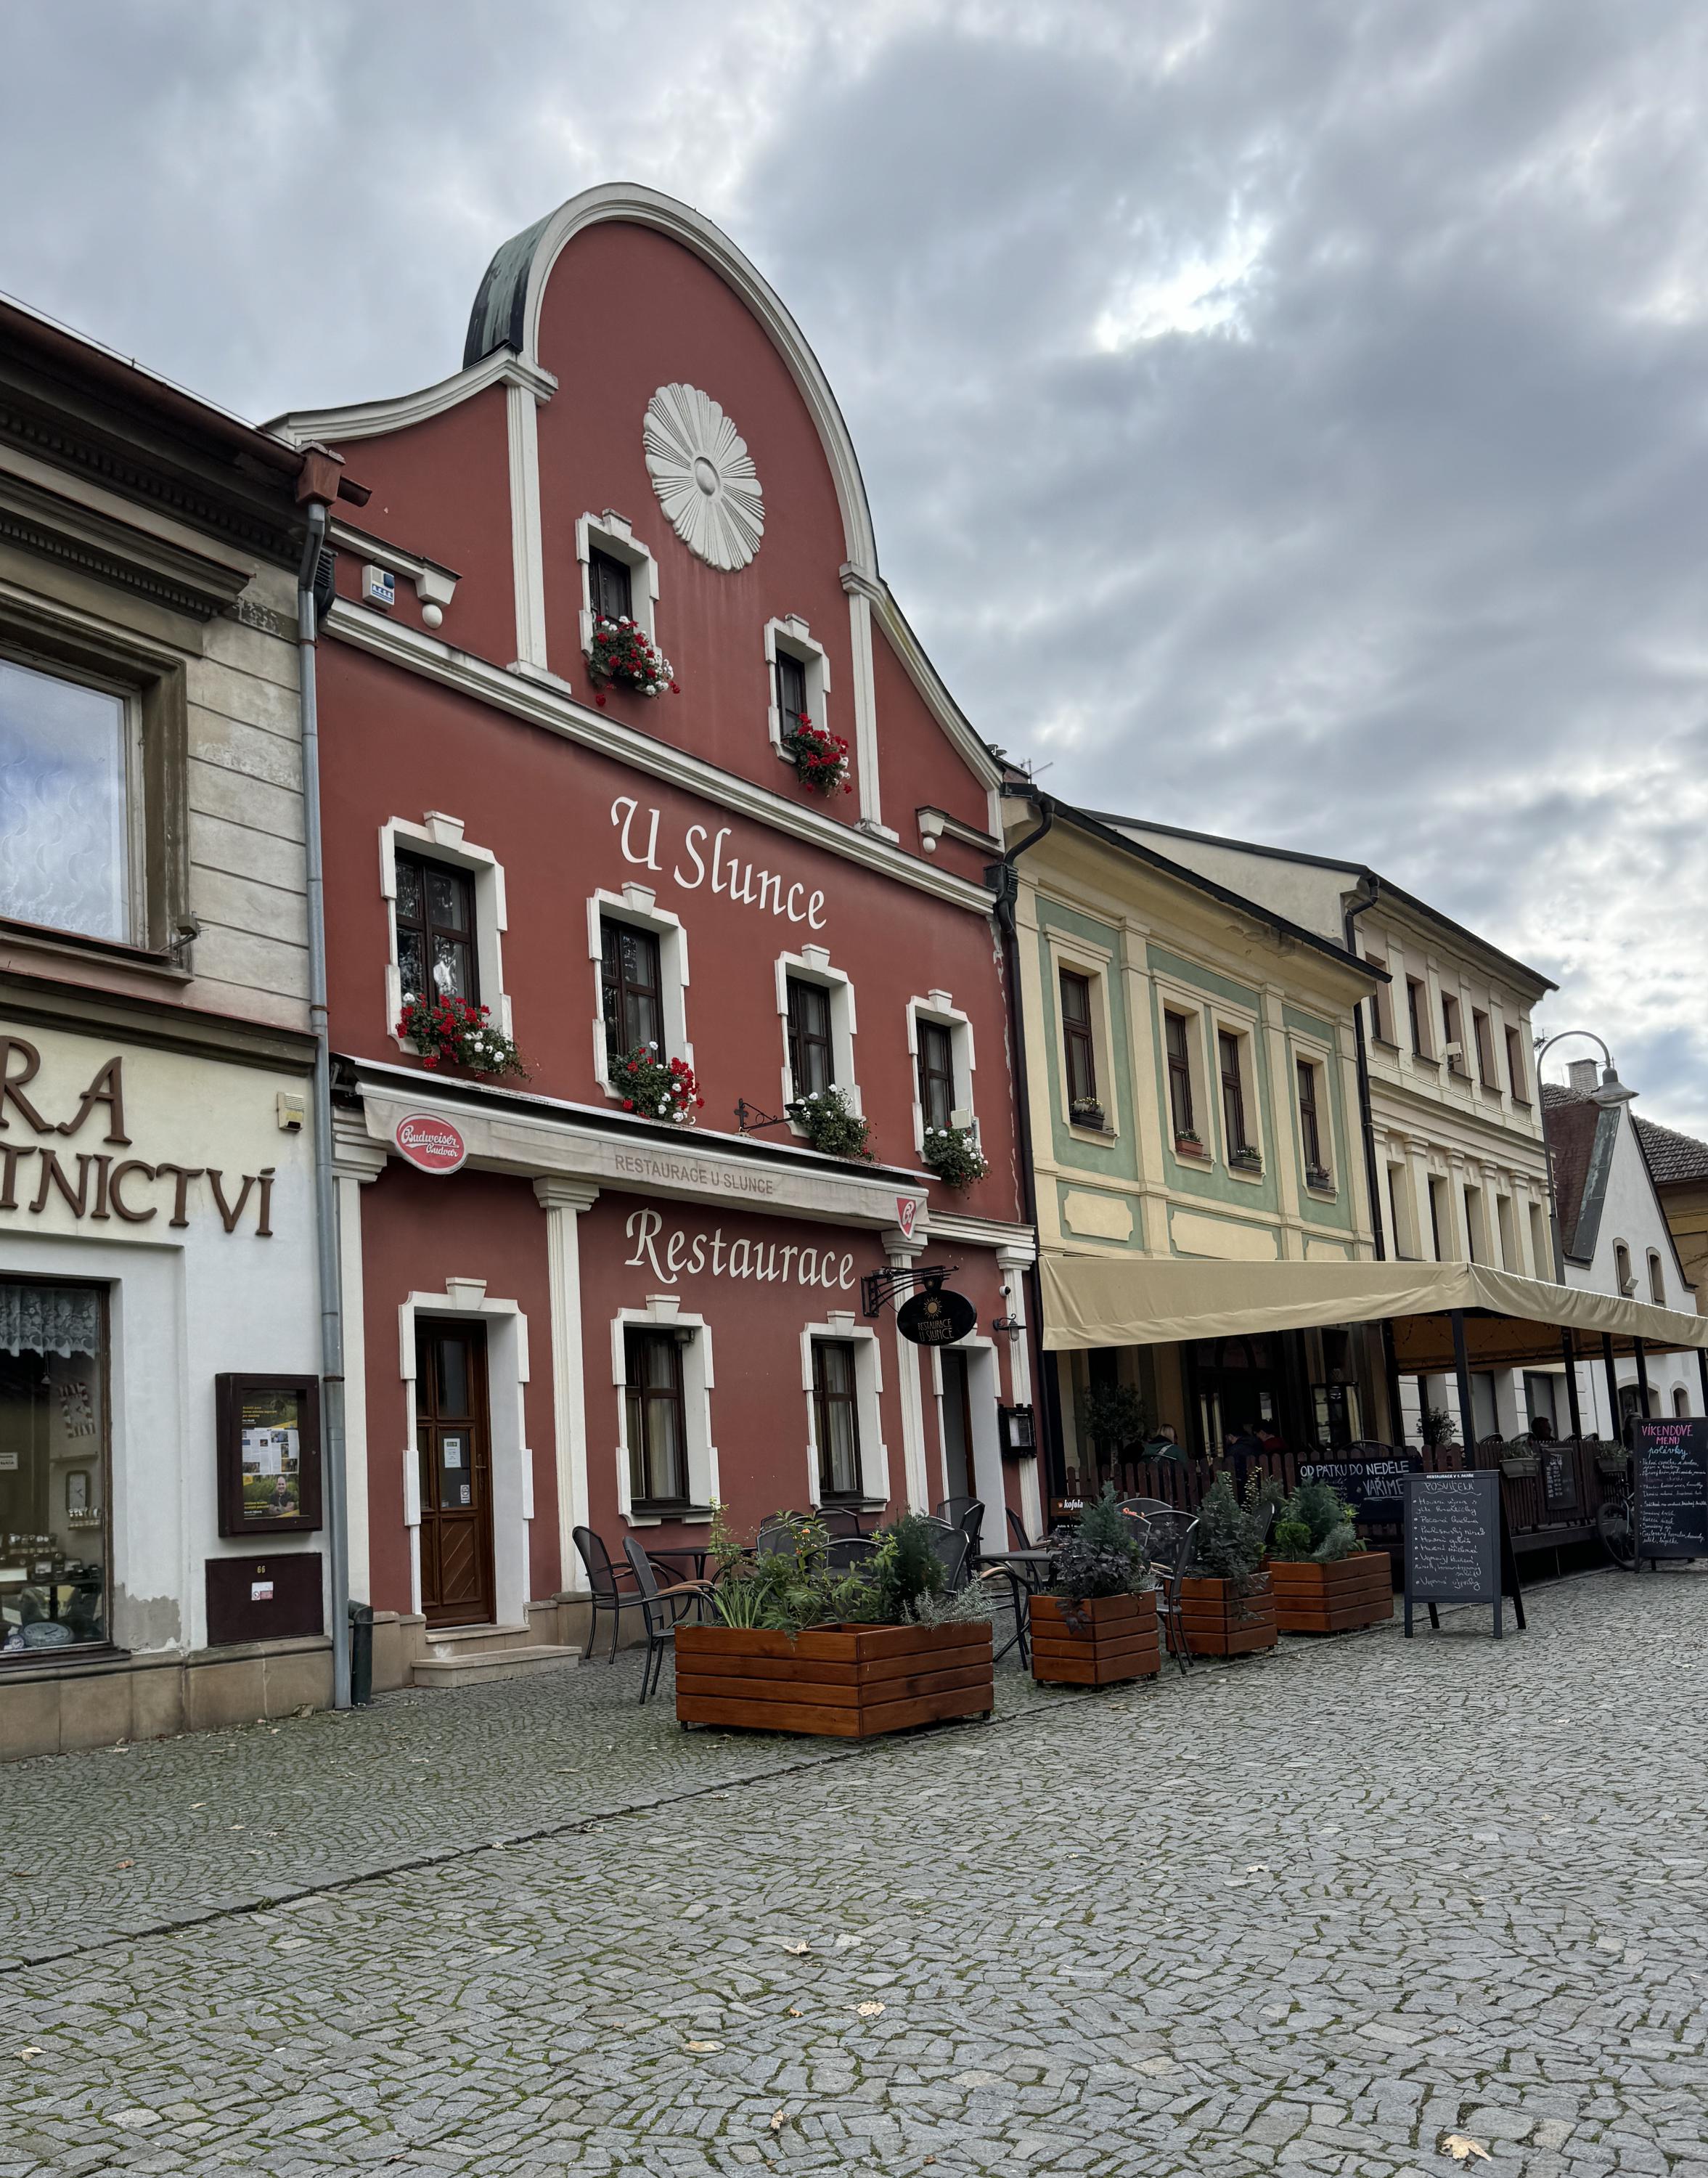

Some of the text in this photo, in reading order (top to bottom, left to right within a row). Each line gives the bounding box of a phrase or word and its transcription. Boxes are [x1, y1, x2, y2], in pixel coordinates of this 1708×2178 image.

[611, 796, 827, 930] U Slunce
[401, 1125, 457, 1146] Budweiser
[425, 1143, 459, 1157] Budvar
[615, 1154, 773, 1195] RESTAURACE U SLUNCE
[624, 1207, 856, 1290] Restaurace
[918, 1318, 952, 1331] RESTAURACE
[920, 1327, 955, 1342] U SLUNCE
[1300, 1465, 1315, 1477] OD
[1349, 1464, 1363, 1475] DO
[1063, 1499, 1084, 1511] kofola
